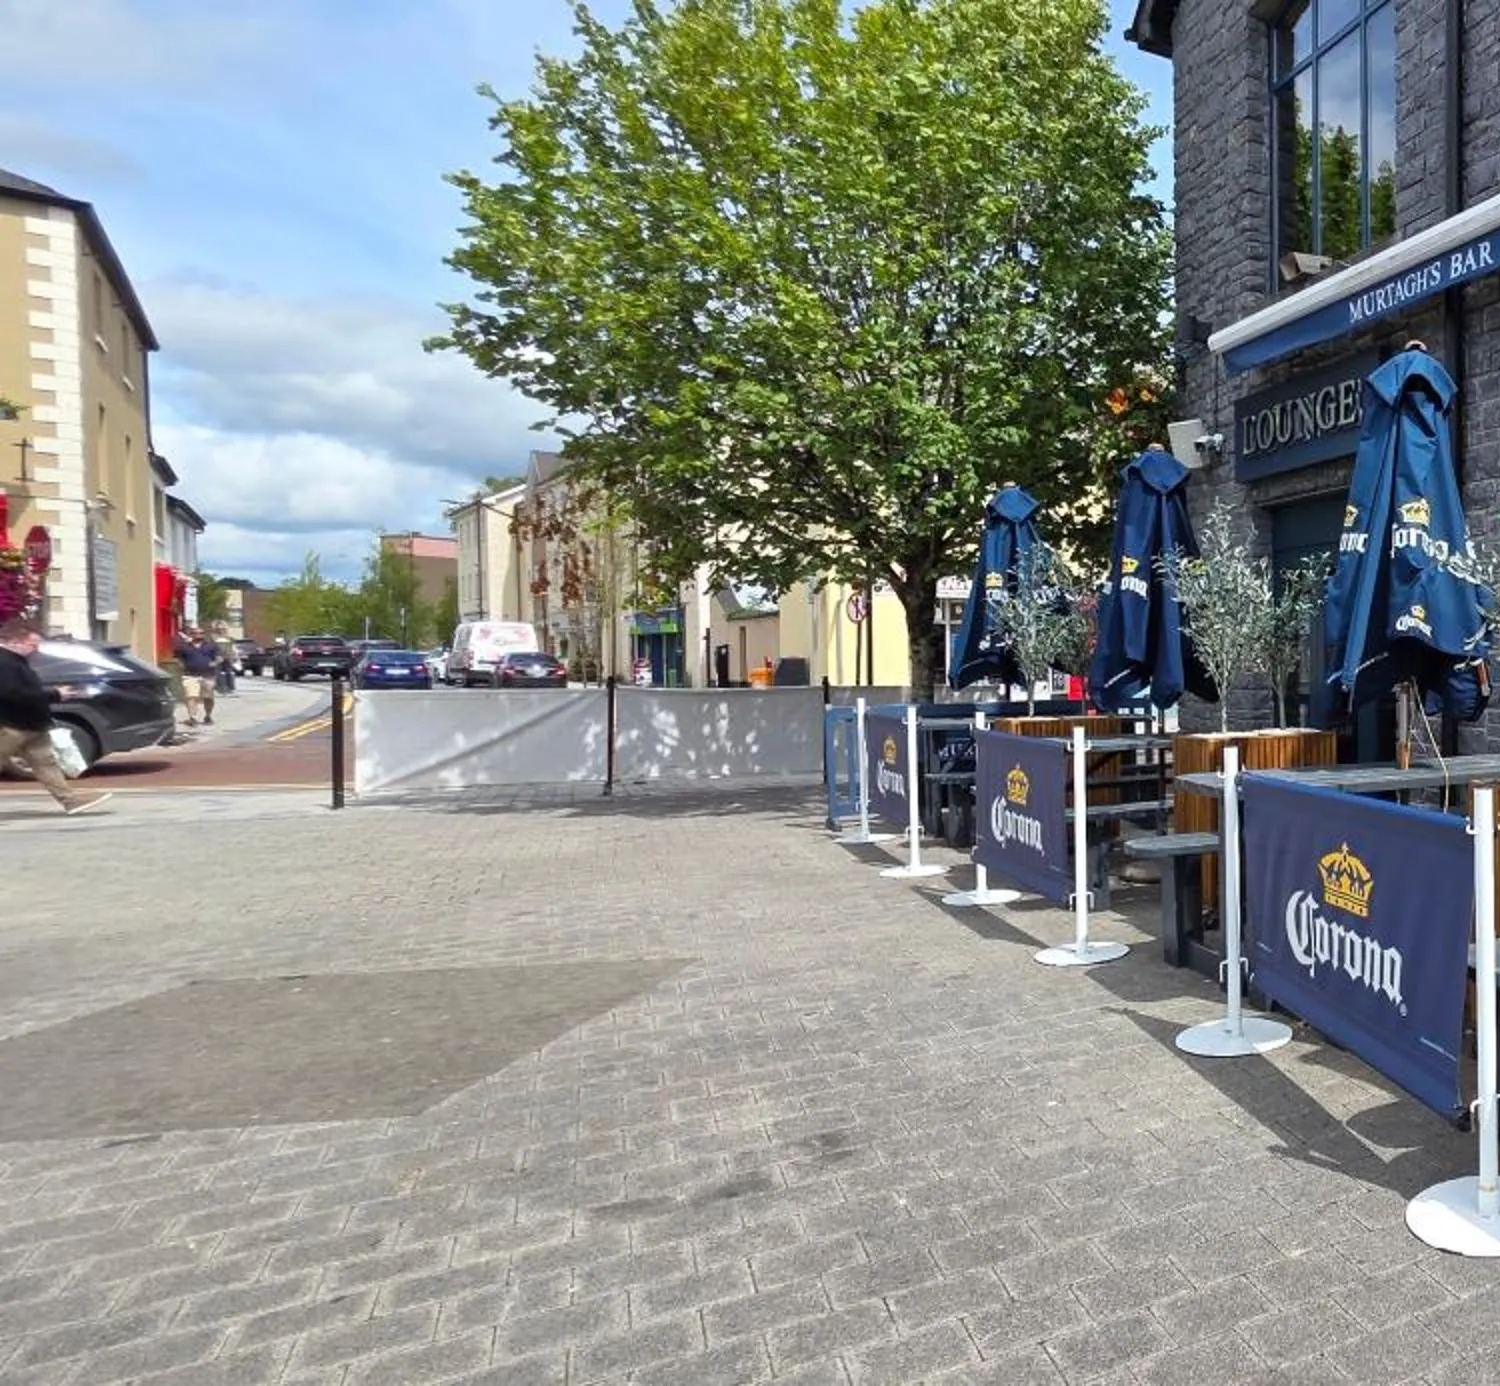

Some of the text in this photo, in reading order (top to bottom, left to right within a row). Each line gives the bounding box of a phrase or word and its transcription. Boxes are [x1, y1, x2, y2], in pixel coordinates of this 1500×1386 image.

[1348, 241, 1495, 323] MURTAGH'S BAR
[1241, 379, 1362, 455] LOUNGE
[991, 795, 1043, 851] Corona
[1285, 889, 1405, 1005] Corona
